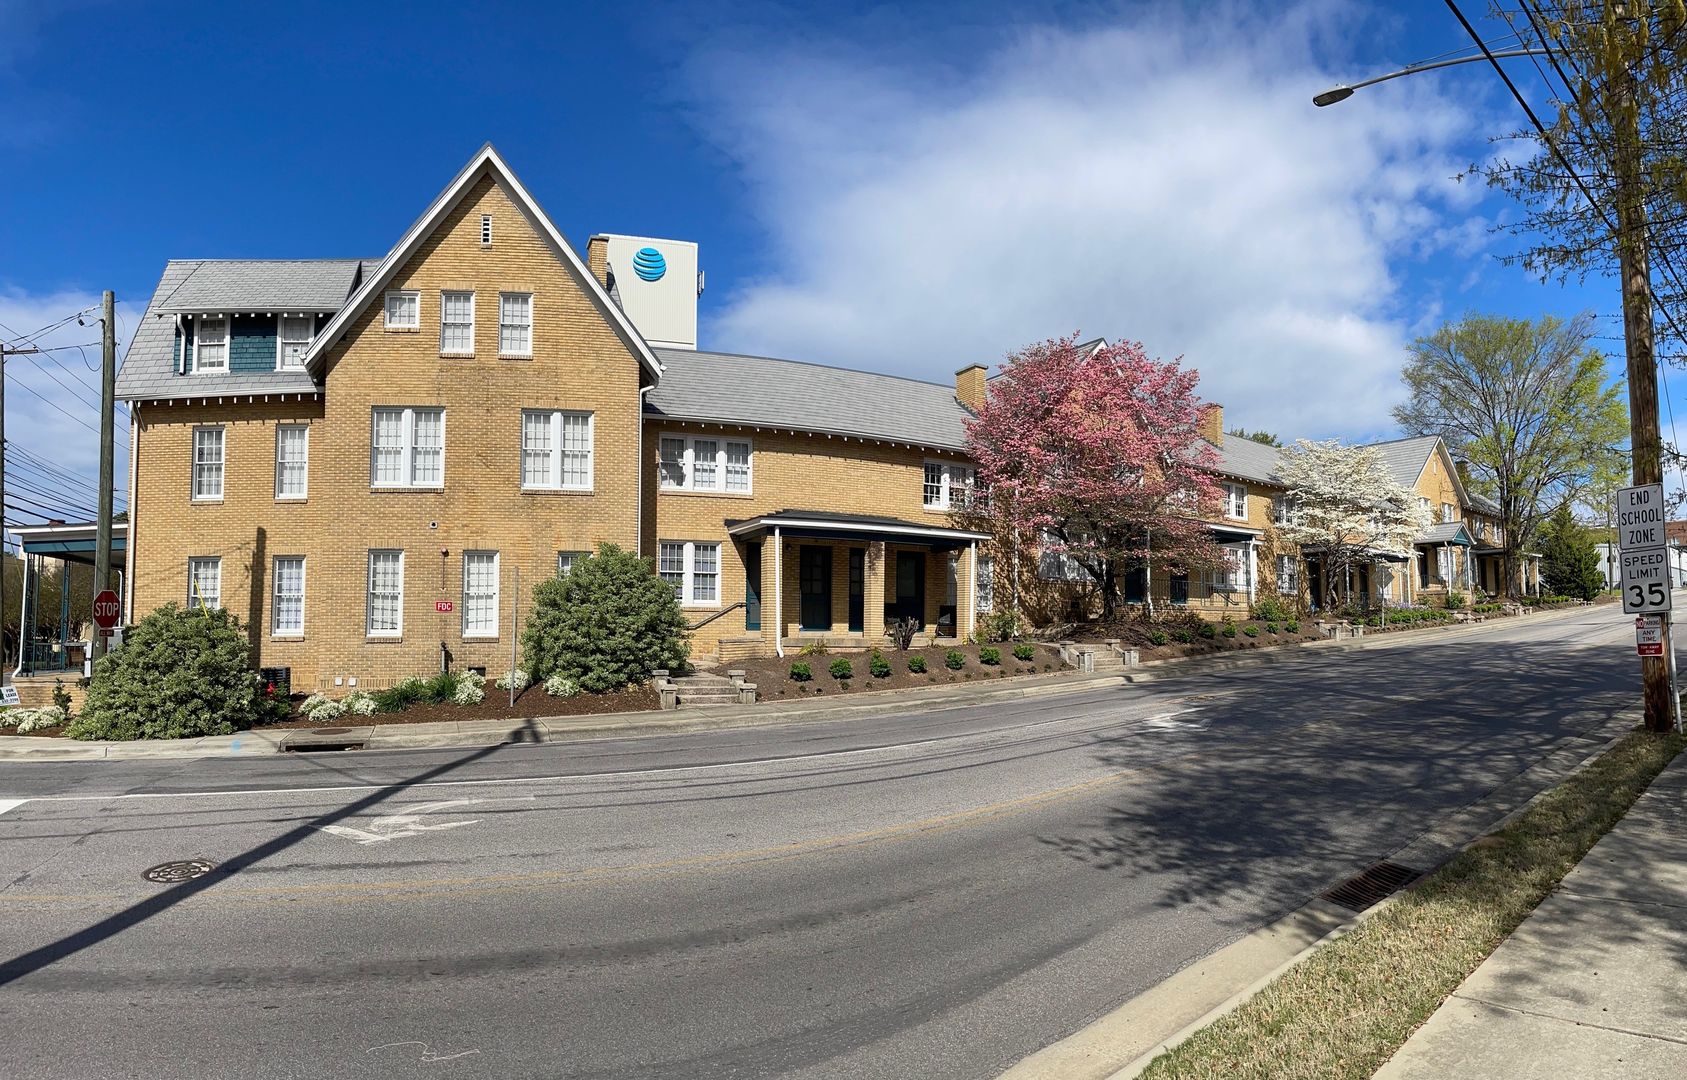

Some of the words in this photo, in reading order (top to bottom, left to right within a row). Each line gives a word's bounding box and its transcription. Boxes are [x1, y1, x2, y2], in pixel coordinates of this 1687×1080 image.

[1630, 491, 1649, 505] END
[1621, 508, 1661, 526] SCHOOL
[1629, 529, 1655, 544] ZONE
[1624, 554, 1663, 567] SPEED
[1629, 568, 1659, 580] LIMIT
[1629, 583, 1665, 608] 35
[95, 602, 118, 617] STOP
[437, 602, 451, 611] FDC
[1636, 620, 1643, 628] NO
